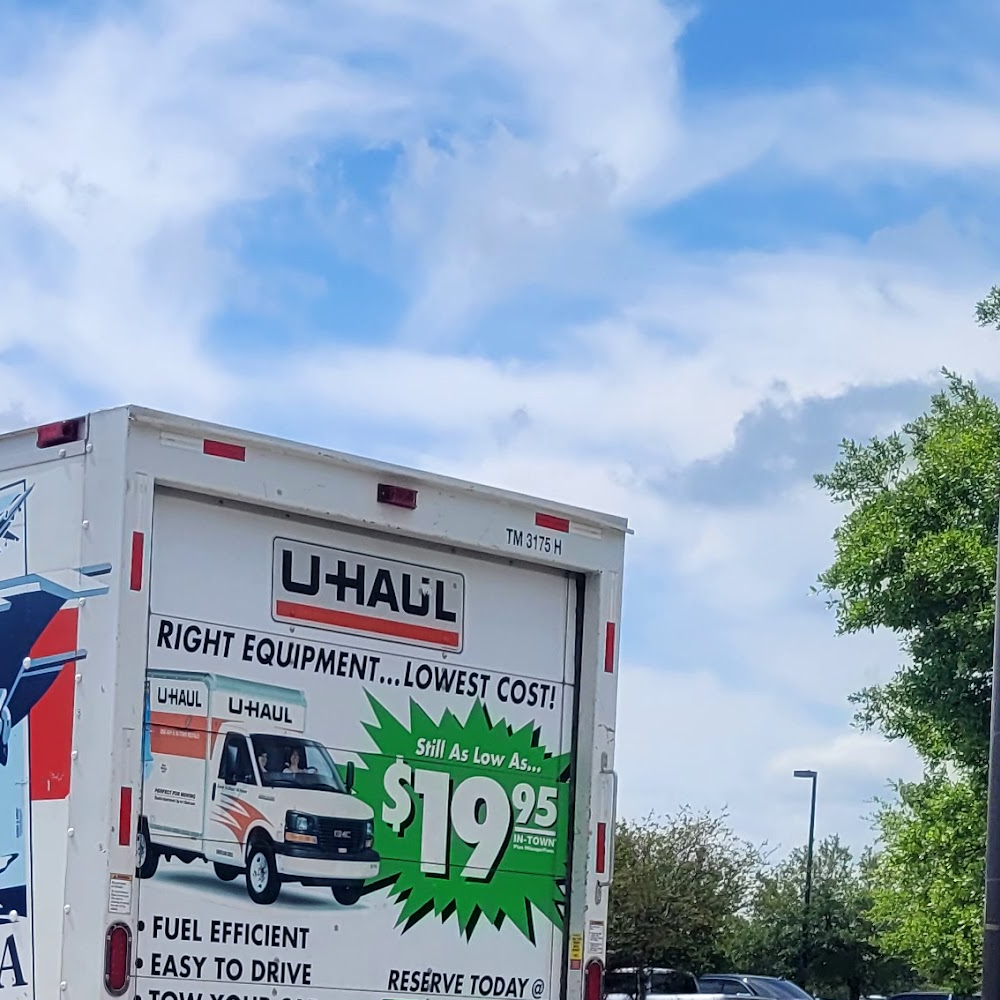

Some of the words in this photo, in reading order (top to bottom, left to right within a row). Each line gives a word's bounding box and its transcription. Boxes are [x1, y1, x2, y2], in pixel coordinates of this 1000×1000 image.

[505, 528, 522, 547] TM
[526, 531, 551, 554] 3175
[553, 539, 562, 555] H
[282, 549, 457, 623] U-HAUL
[157, 619, 235, 658] RIGHT
[497, 676, 557, 710] COST!
[157, 686, 202, 708] U-HAUL
[228, 696, 293, 724] U-HAUL
[415, 737, 446, 759] Still
[448, 743, 469, 762] As
[473, 746, 506, 767] Low
[508, 752, 542, 774] As...
[513, 833, 555, 847] IN-TOWN
[152, 915, 202, 942] FUEL
[210, 920, 310, 949] EFFICIENT
[151, 952, 207, 979] EASY
[214, 957, 243, 981] TO
[251, 959, 312, 985] DRIVE
[387, 969, 465, 995] RESERVE
[470, 975, 530, 999] TODAY
[531, 978, 545, 999] @
